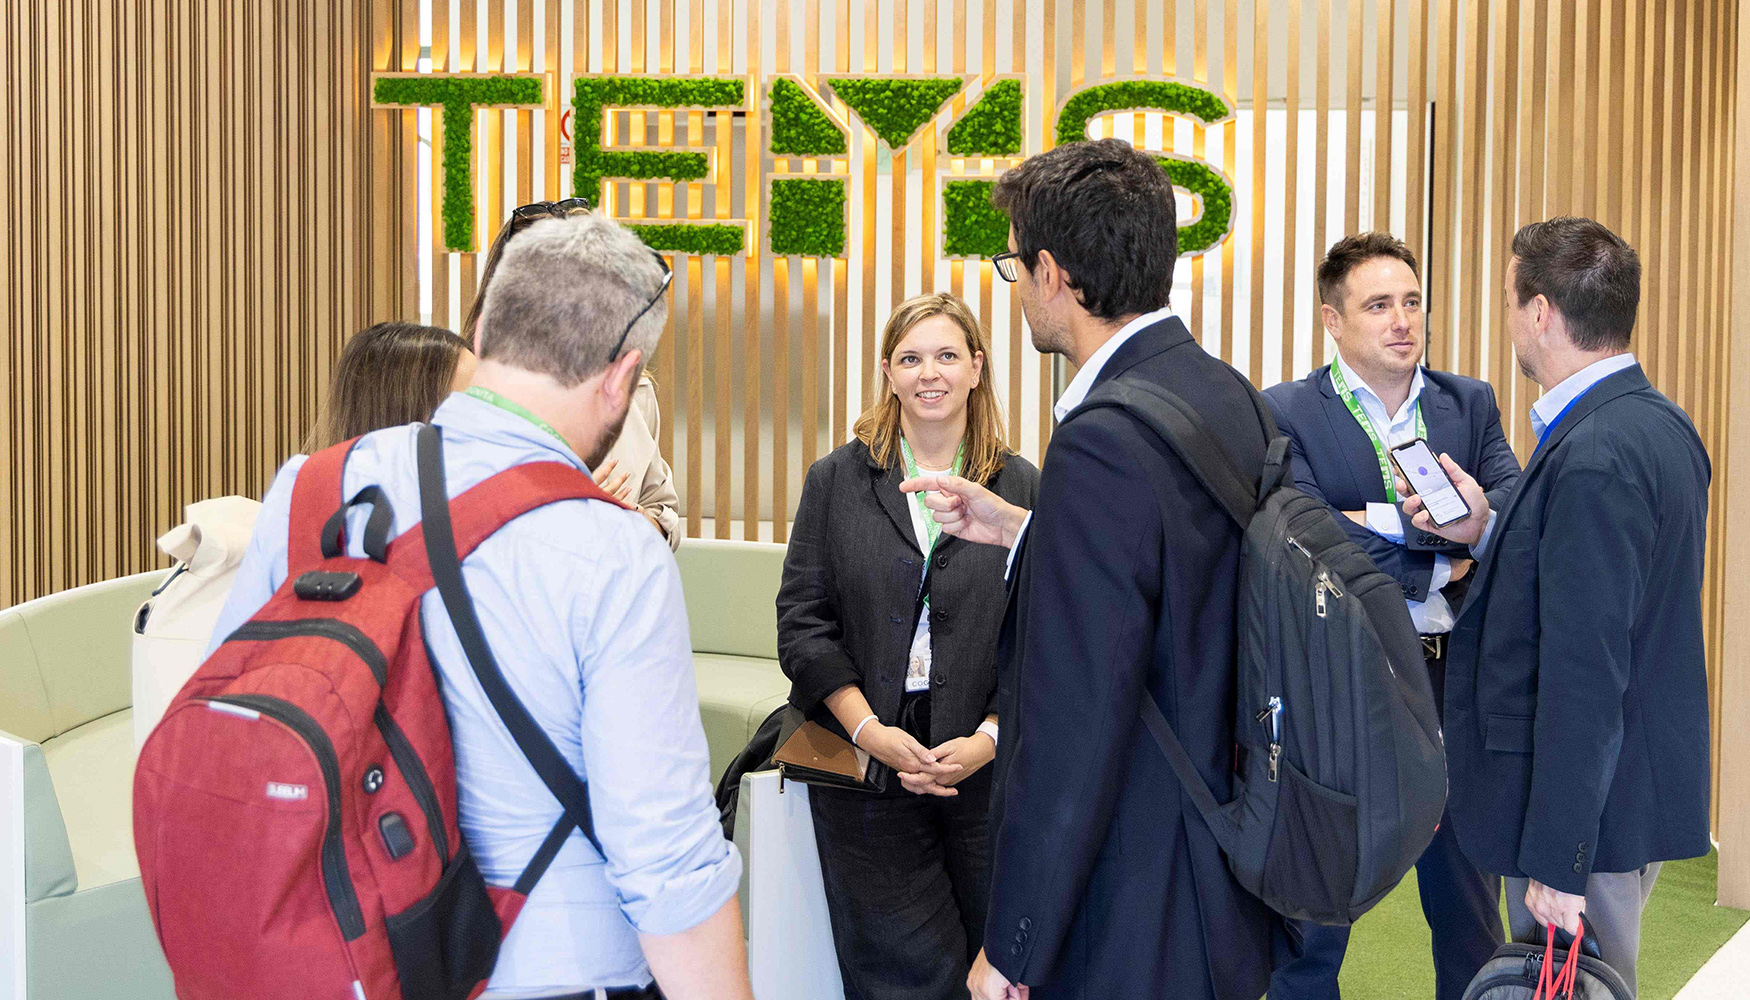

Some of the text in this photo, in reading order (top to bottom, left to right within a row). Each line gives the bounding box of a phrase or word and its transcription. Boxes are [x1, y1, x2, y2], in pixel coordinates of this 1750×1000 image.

[1333, 370, 1352, 402] TEMS
[1352, 405, 1377, 441] TEMS
[1377, 447, 1393, 490] TEMS
